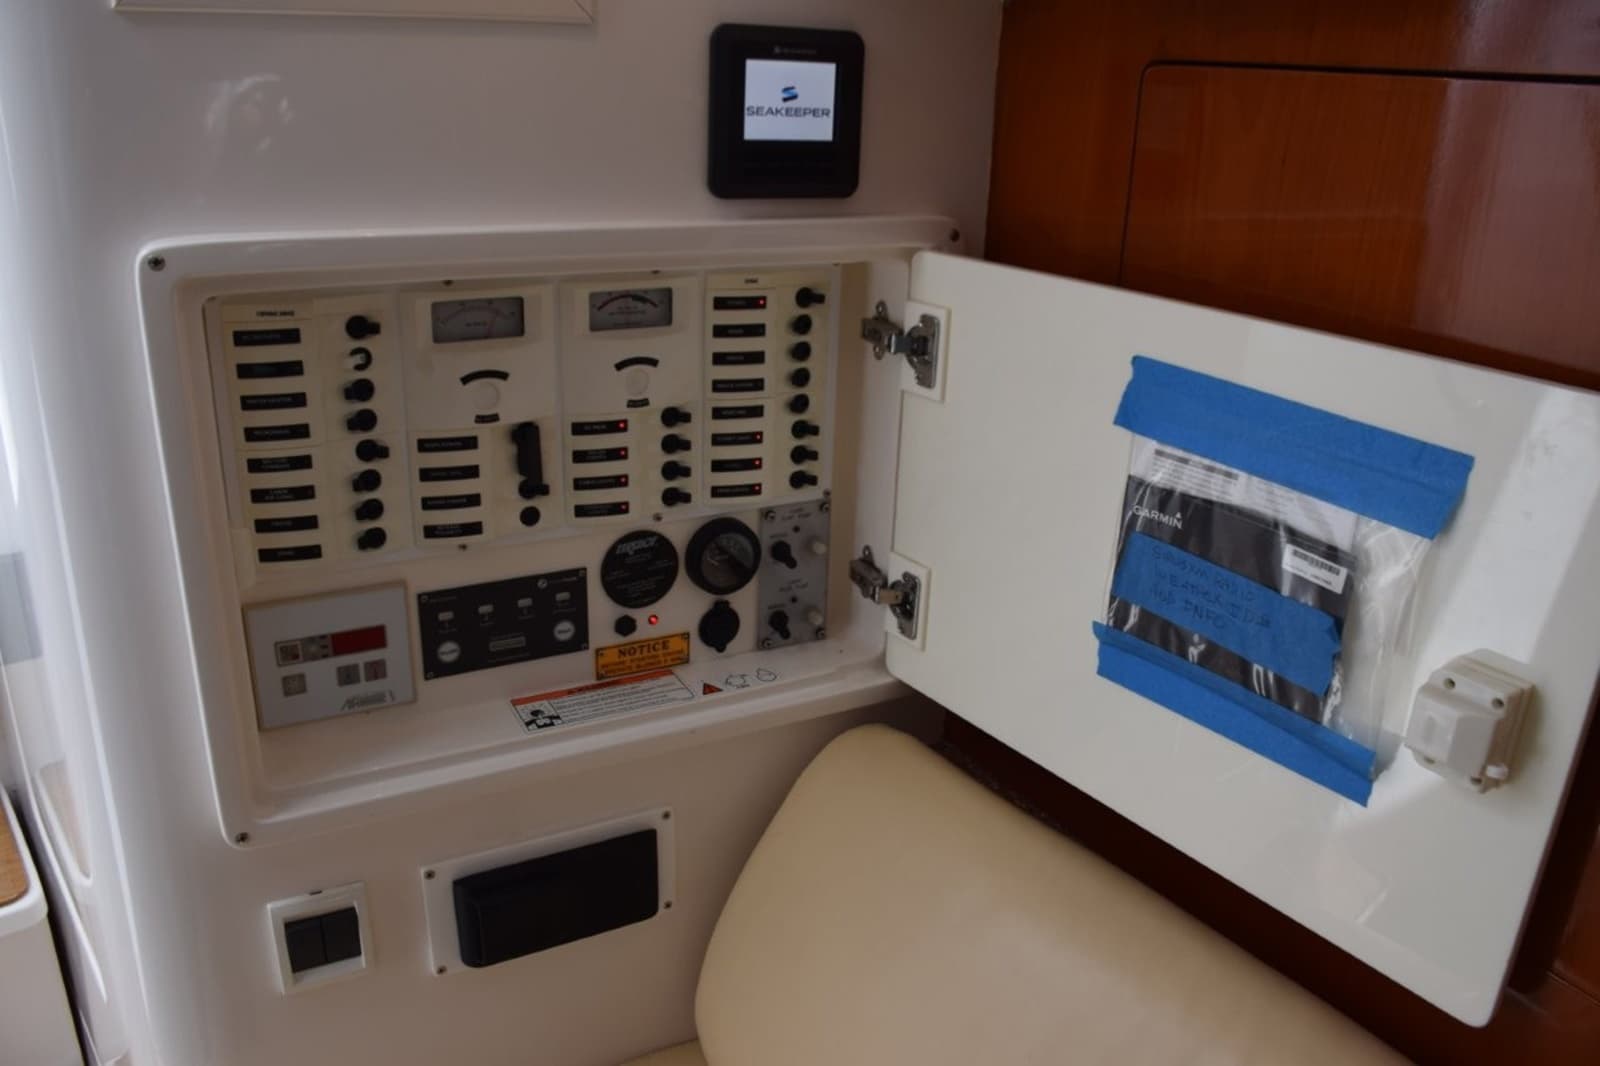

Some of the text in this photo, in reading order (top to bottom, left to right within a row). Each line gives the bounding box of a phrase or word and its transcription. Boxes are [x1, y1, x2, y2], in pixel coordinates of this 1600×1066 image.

[745, 105, 831, 118] SEAKEEPER
[1132, 504, 1184, 530] GARMIN
[617, 639, 671, 660] NOTICE
